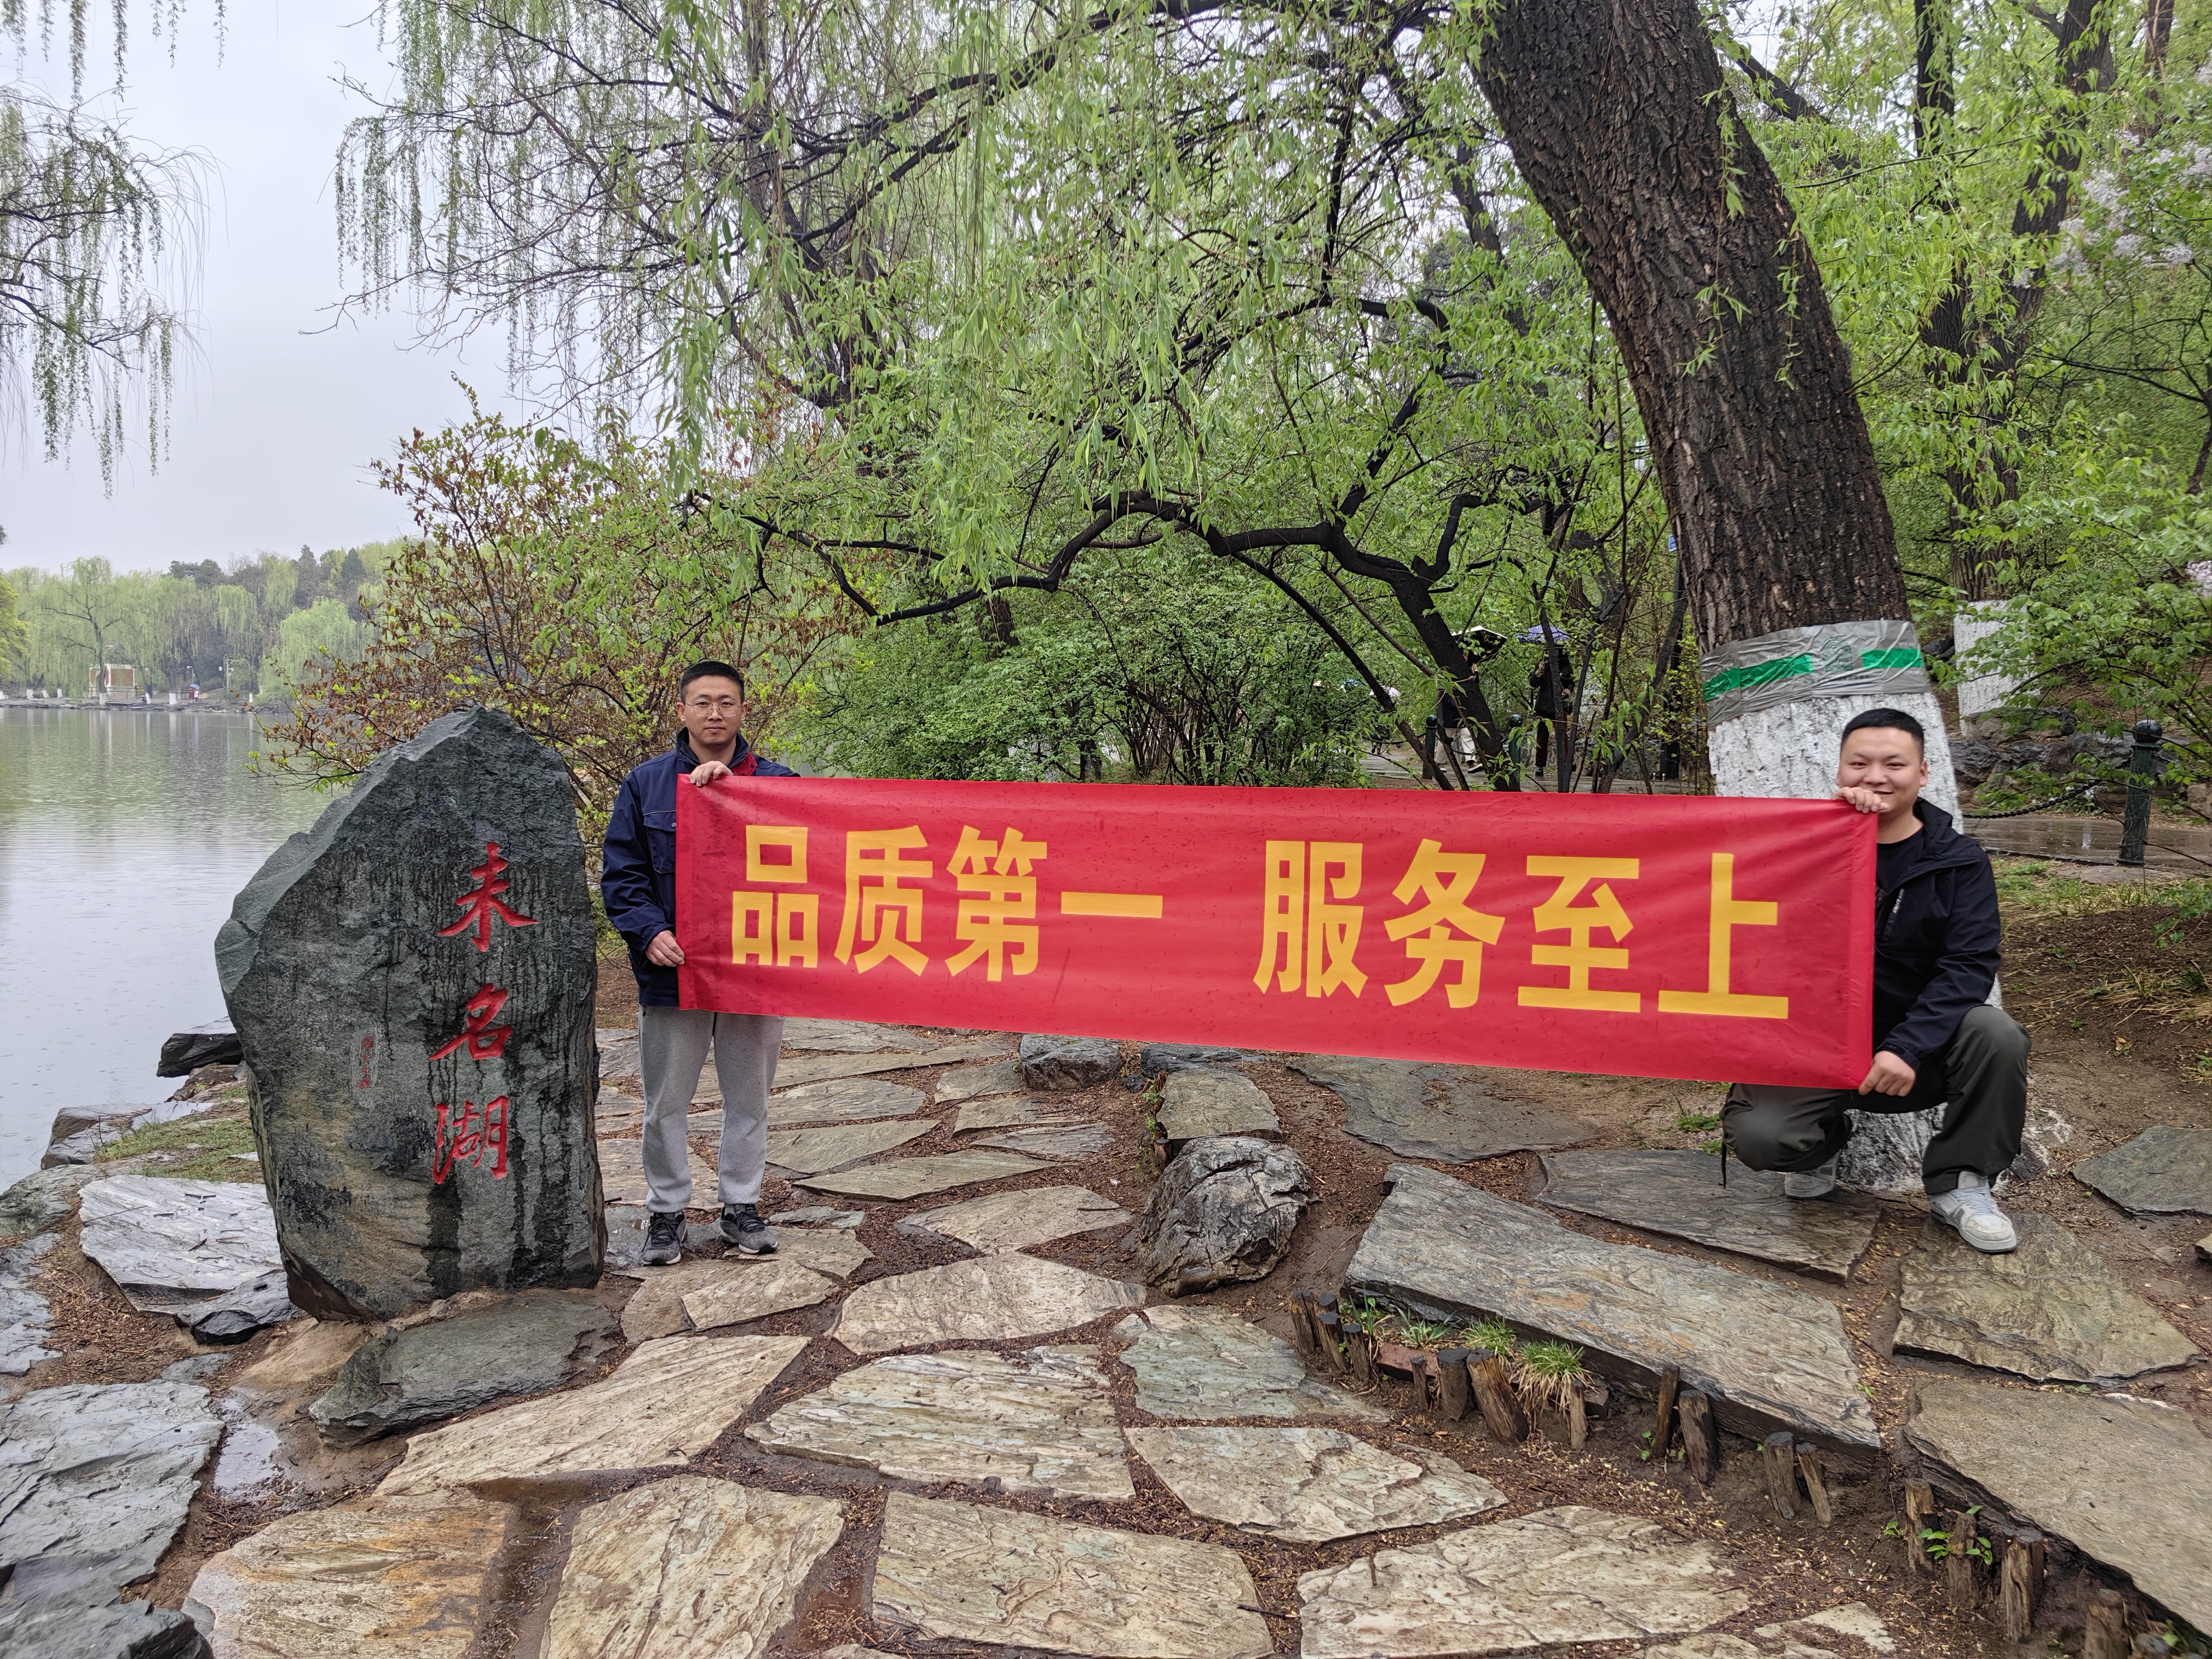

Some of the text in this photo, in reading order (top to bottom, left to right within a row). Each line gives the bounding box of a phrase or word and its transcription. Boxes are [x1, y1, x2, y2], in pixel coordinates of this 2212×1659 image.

[430, 842, 538, 1185] 未名湖
[731, 824, 1789, 1019] 品质第一 服务至上
